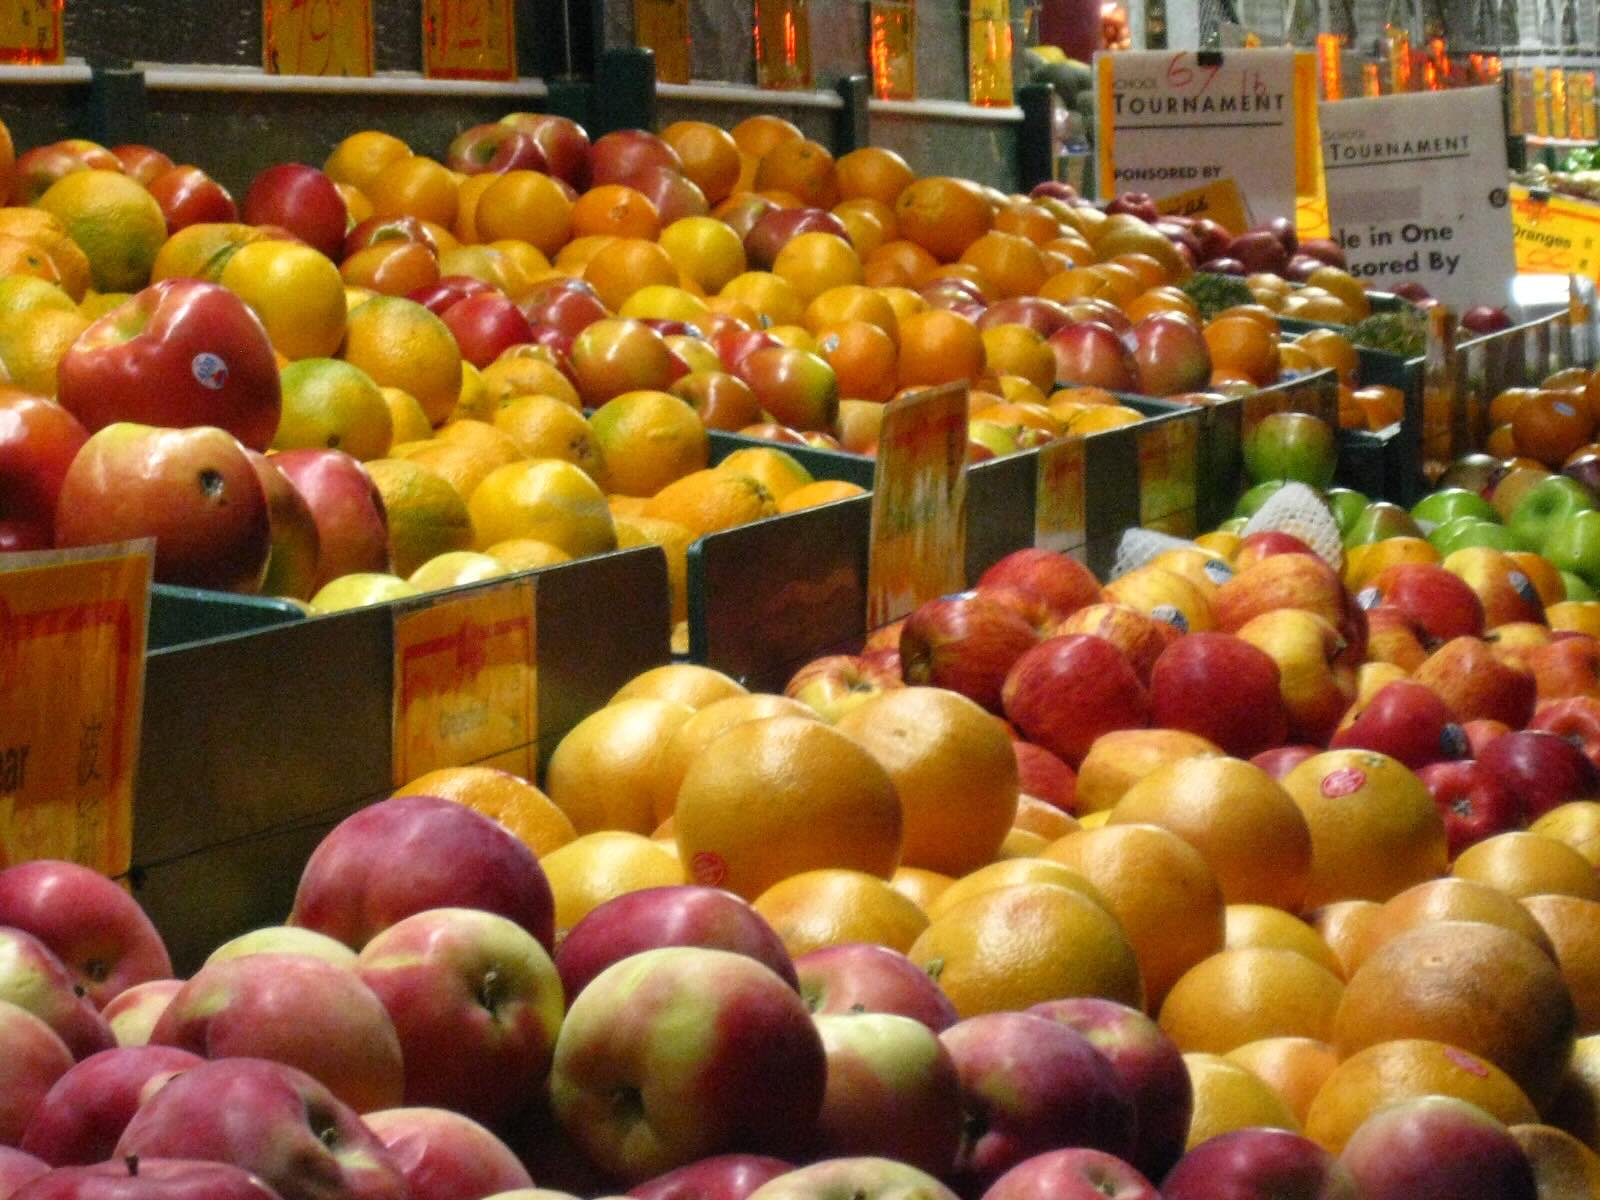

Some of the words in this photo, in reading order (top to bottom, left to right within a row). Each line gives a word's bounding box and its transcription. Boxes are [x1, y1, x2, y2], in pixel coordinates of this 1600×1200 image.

[1114, 93, 1285, 115] TOURNAMENT
[1329, 135, 1470, 161] TOURNAMENT
[1202, 165, 1223, 179] BY
[1331, 228, 1361, 249] le
[1369, 226, 1393, 247] in
[1401, 223, 1454, 244] One
[1346, 251, 1420, 277] sored
[1429, 251, 1461, 275] By
